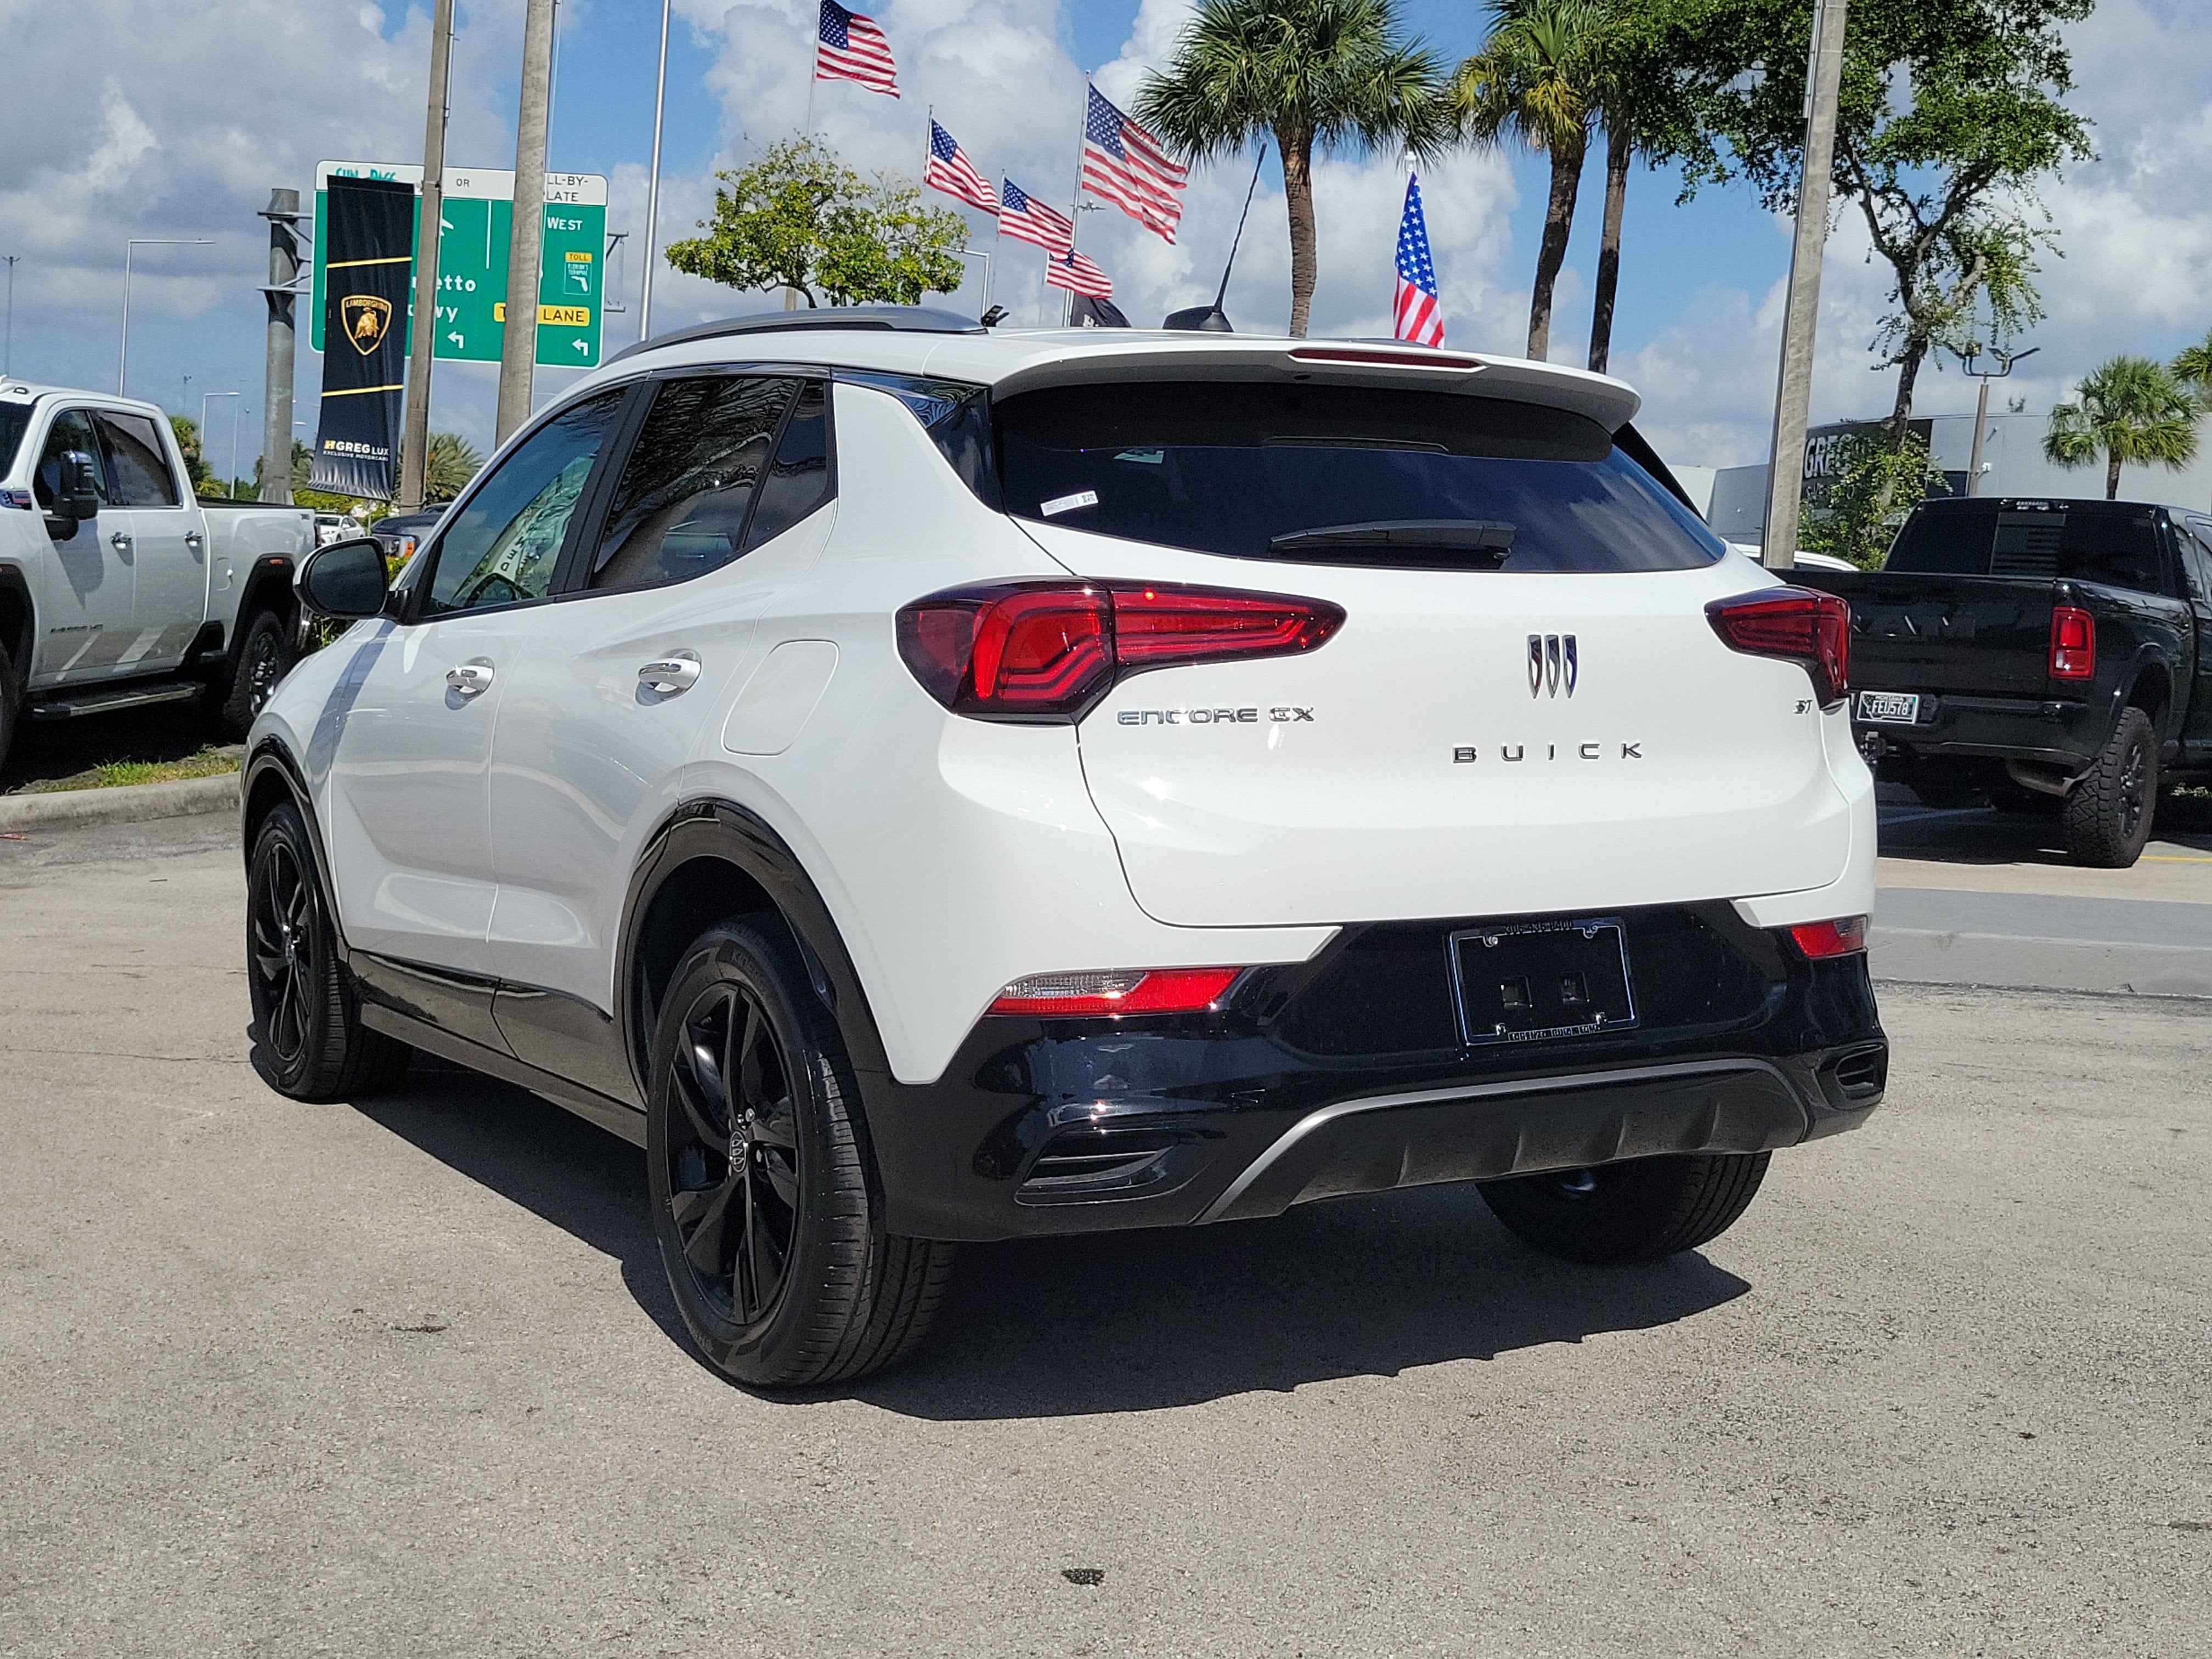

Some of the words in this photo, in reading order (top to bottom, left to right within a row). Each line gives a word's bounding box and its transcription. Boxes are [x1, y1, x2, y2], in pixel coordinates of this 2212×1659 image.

[456, 178, 470, 187] OR
[543, 191, 579, 202] LATE
[547, 216, 583, 230] WEST
[544, 308, 584, 323] LANE
[371, 445, 389, 456] LUX
[1871, 700, 1909, 715] FEU578
[1117, 708, 1258, 725] ENCORE
[1268, 707, 1315, 722] GX
[1453, 742, 1643, 763] BUICK
